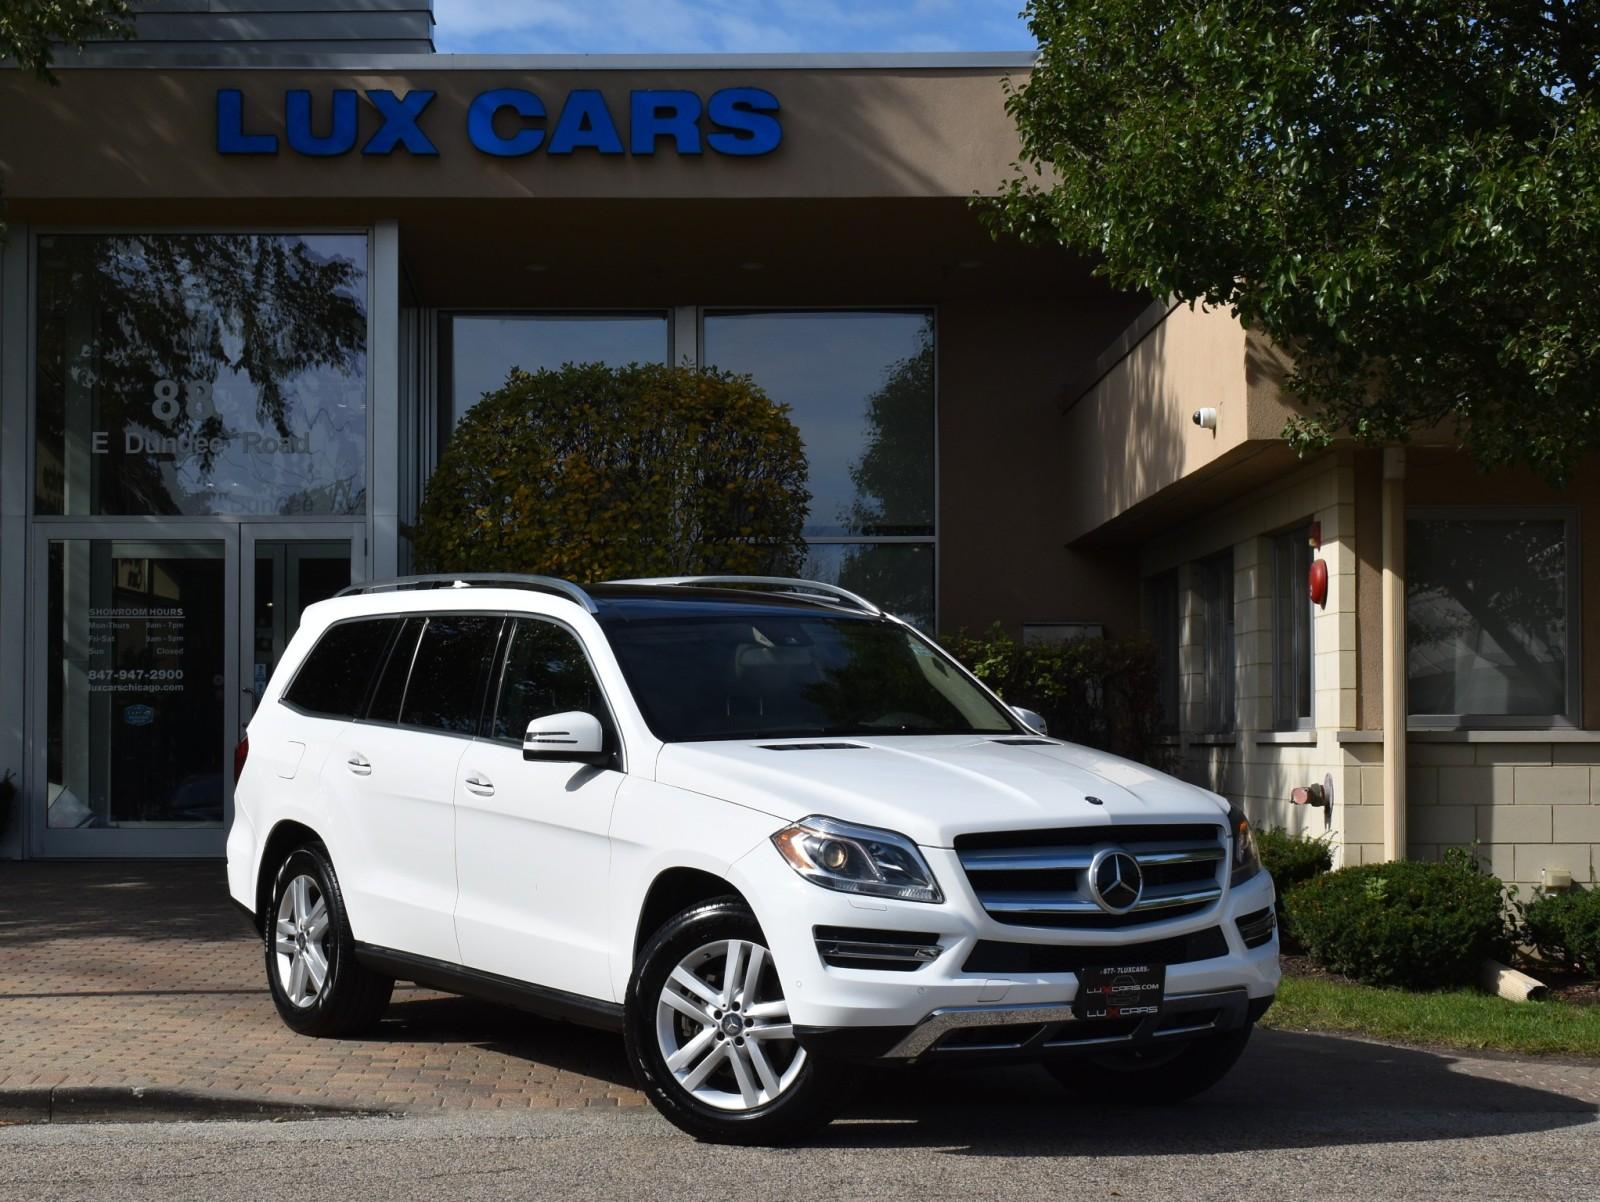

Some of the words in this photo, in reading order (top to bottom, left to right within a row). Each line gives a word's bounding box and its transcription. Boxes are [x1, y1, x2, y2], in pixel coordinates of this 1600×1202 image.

[216, 88, 440, 156] LUX
[467, 86, 783, 157] CARS
[151, 378, 215, 422] 88
[91, 431, 110, 454] E
[124, 431, 226, 455] Dundee
[241, 431, 311, 455] Road
[88, 608, 148, 616] SHOWROOM
[149, 608, 184, 616] HOURS
[156, 646, 184, 656] Closed
[88, 669, 184, 681] 847-947-2900
[88, 682, 184, 693] luxcarschicago.com
